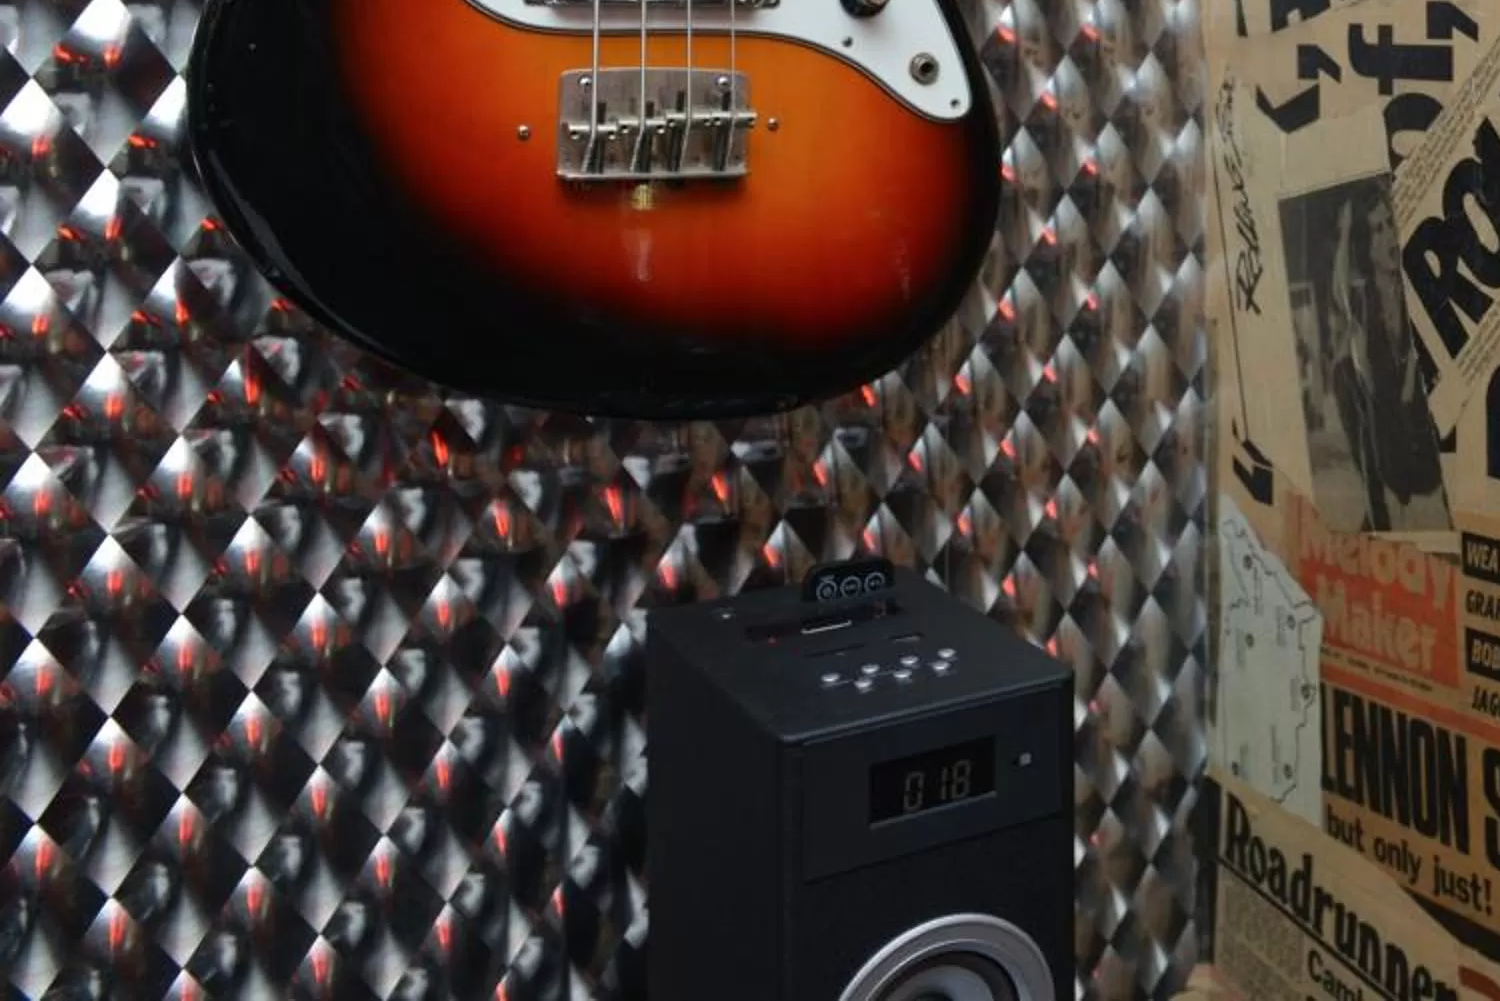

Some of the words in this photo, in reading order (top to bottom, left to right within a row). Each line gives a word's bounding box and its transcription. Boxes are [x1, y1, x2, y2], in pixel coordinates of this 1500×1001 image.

[1316, 573, 1437, 672] Maker
[1320, 682, 1469, 855] LENNON
[1327, 803, 1365, 853] but
[1374, 835, 1423, 885] only
[1433, 854, 1493, 917] just!
